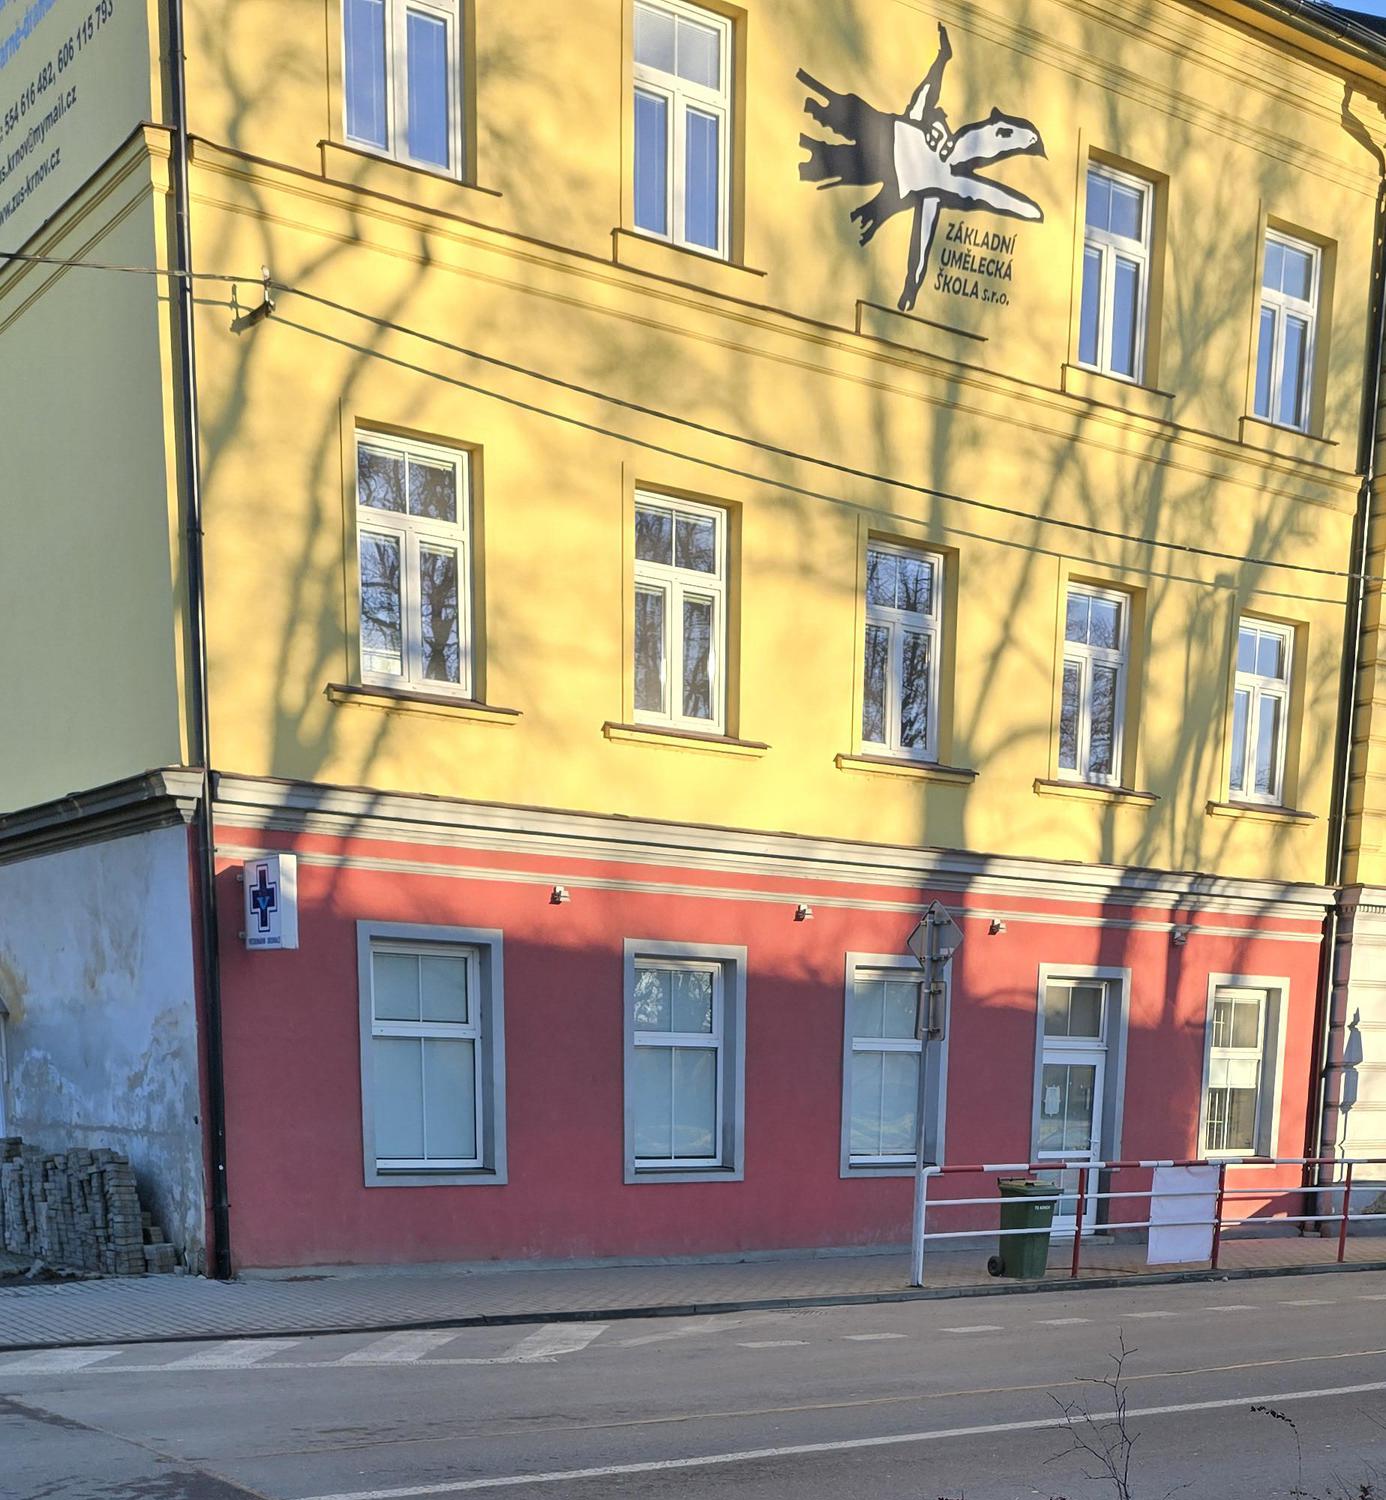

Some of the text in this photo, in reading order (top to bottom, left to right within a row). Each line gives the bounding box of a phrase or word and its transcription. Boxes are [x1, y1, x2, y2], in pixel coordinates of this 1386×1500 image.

[4, 101, 19, 136] 554
[20, 81, 36, 117] 616
[37, 61, 56, 95] 482,
[58, 36, 75, 74] 606
[76, 14, 94, 52] 115
[945, 221, 1018, 255] ZÁKLADNÍ
[940, 248, 1014, 281] UMĚLECKÁ
[934, 268, 1010, 306] ŠKOLA s.r.o.
